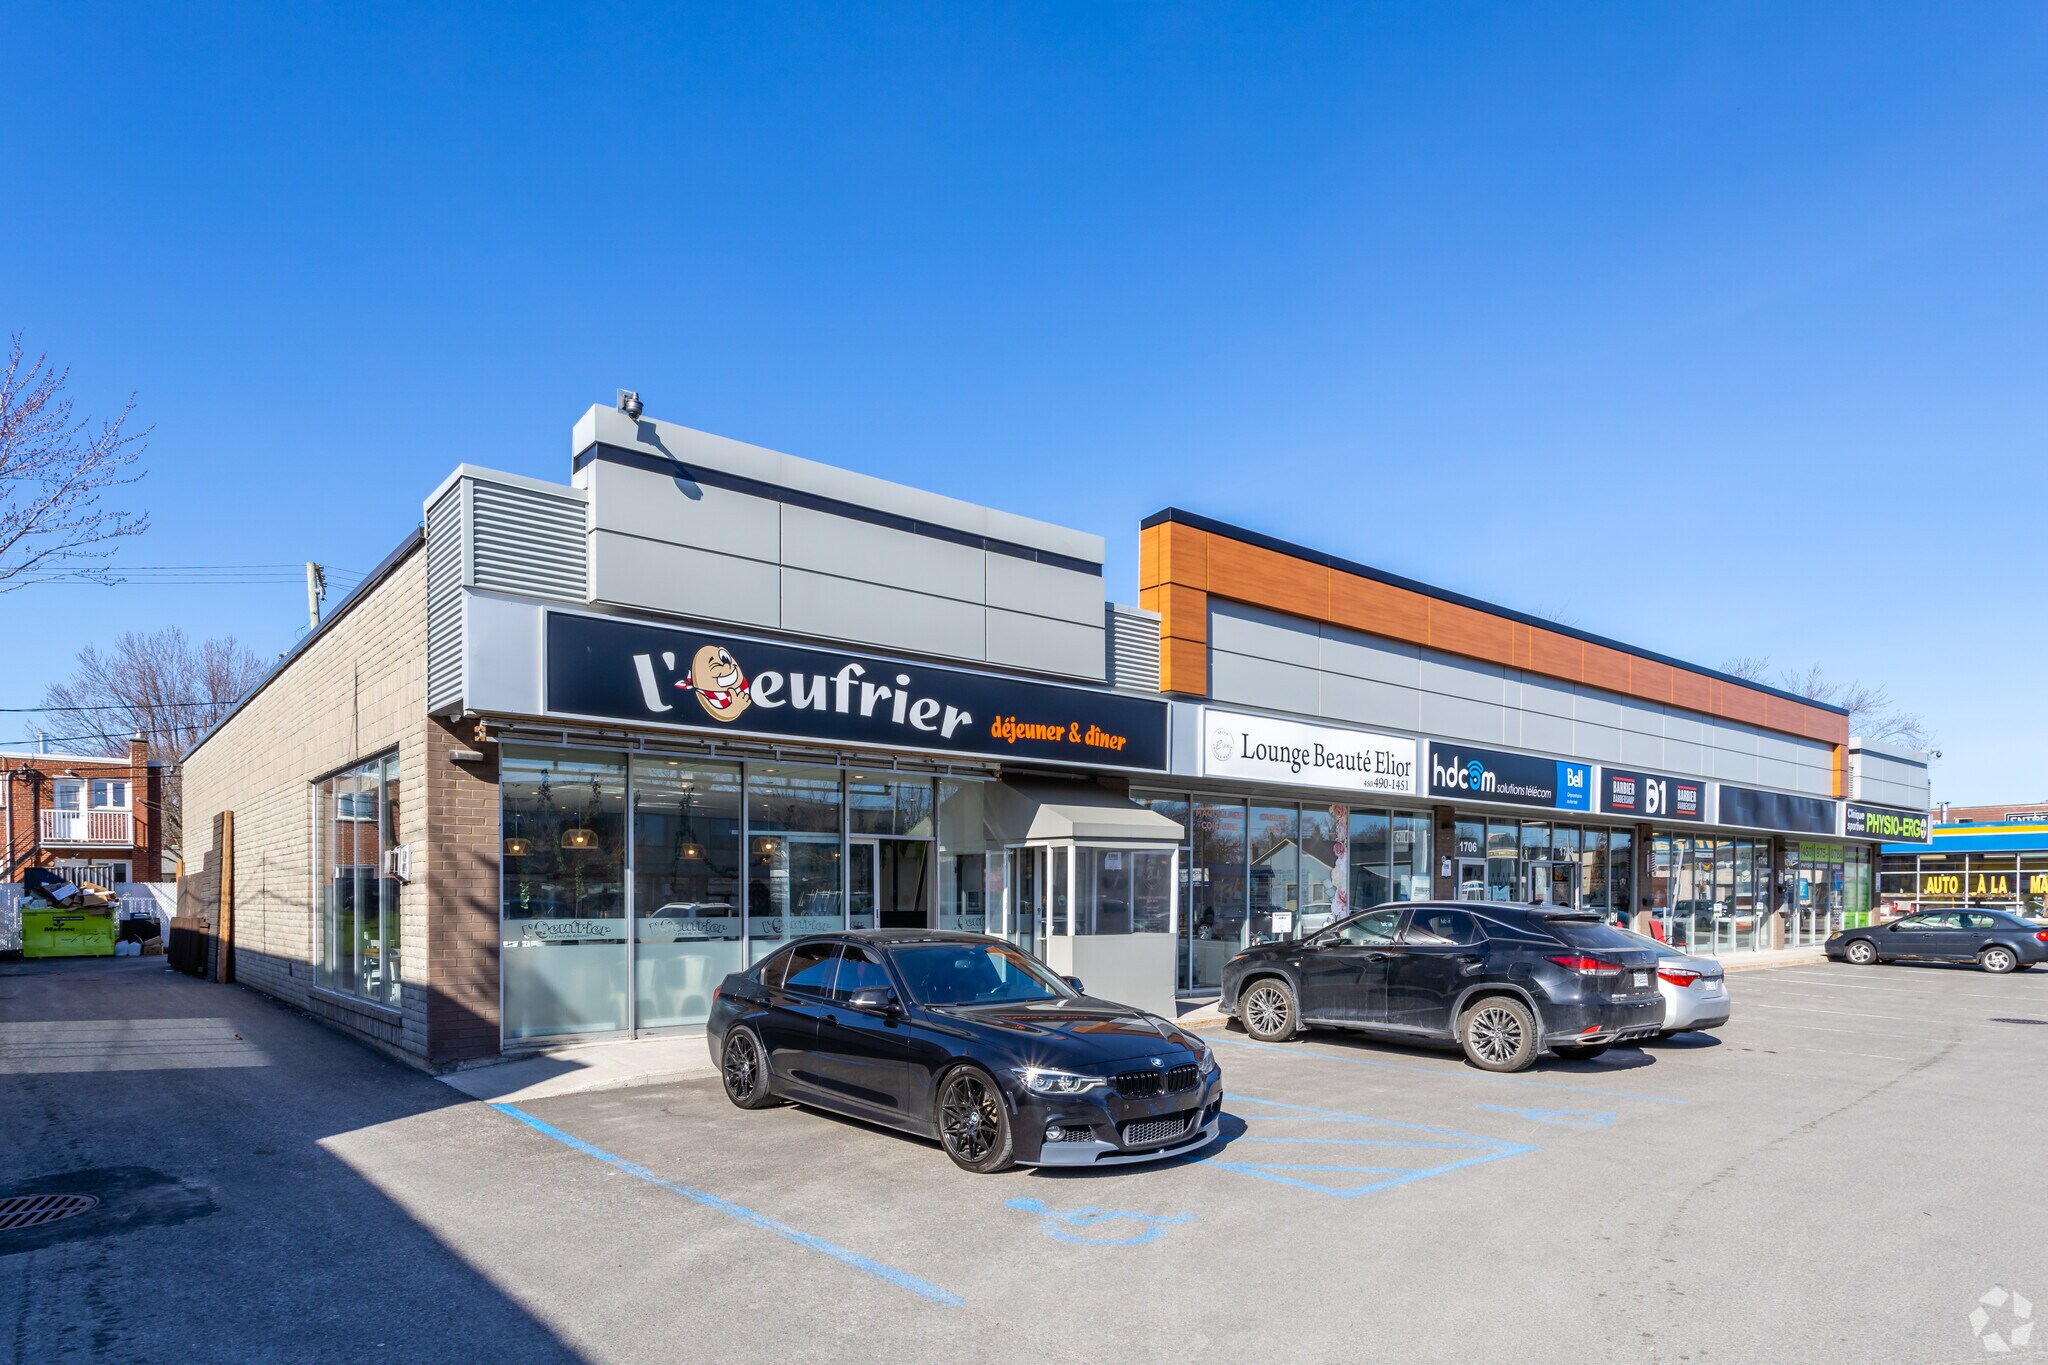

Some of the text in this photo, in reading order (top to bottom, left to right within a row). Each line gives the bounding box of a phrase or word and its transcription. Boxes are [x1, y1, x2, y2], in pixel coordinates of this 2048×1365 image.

[991, 715, 1126, 751] déjeuner & dîner
[1241, 733, 1310, 773] Lounge
[1313, 742, 1371, 773] Beauté
[1374, 750, 1411, 777] Elior
[1433, 753, 1496, 793] hdcom
[1496, 783, 1525, 796] solutions
[1526, 784, 1552, 798] télécom
[1567, 767, 1583, 788] Bell
[1612, 780, 1635, 795] BARBIER
[1677, 789, 1697, 803] BARBIER
[1847, 808, 1865, 821] Clinique
[1847, 822, 1865, 832] sportive
[1460, 841, 1477, 852] 1706
[1926, 875, 1959, 894] AUTO
[1991, 875, 2007, 894] LA
